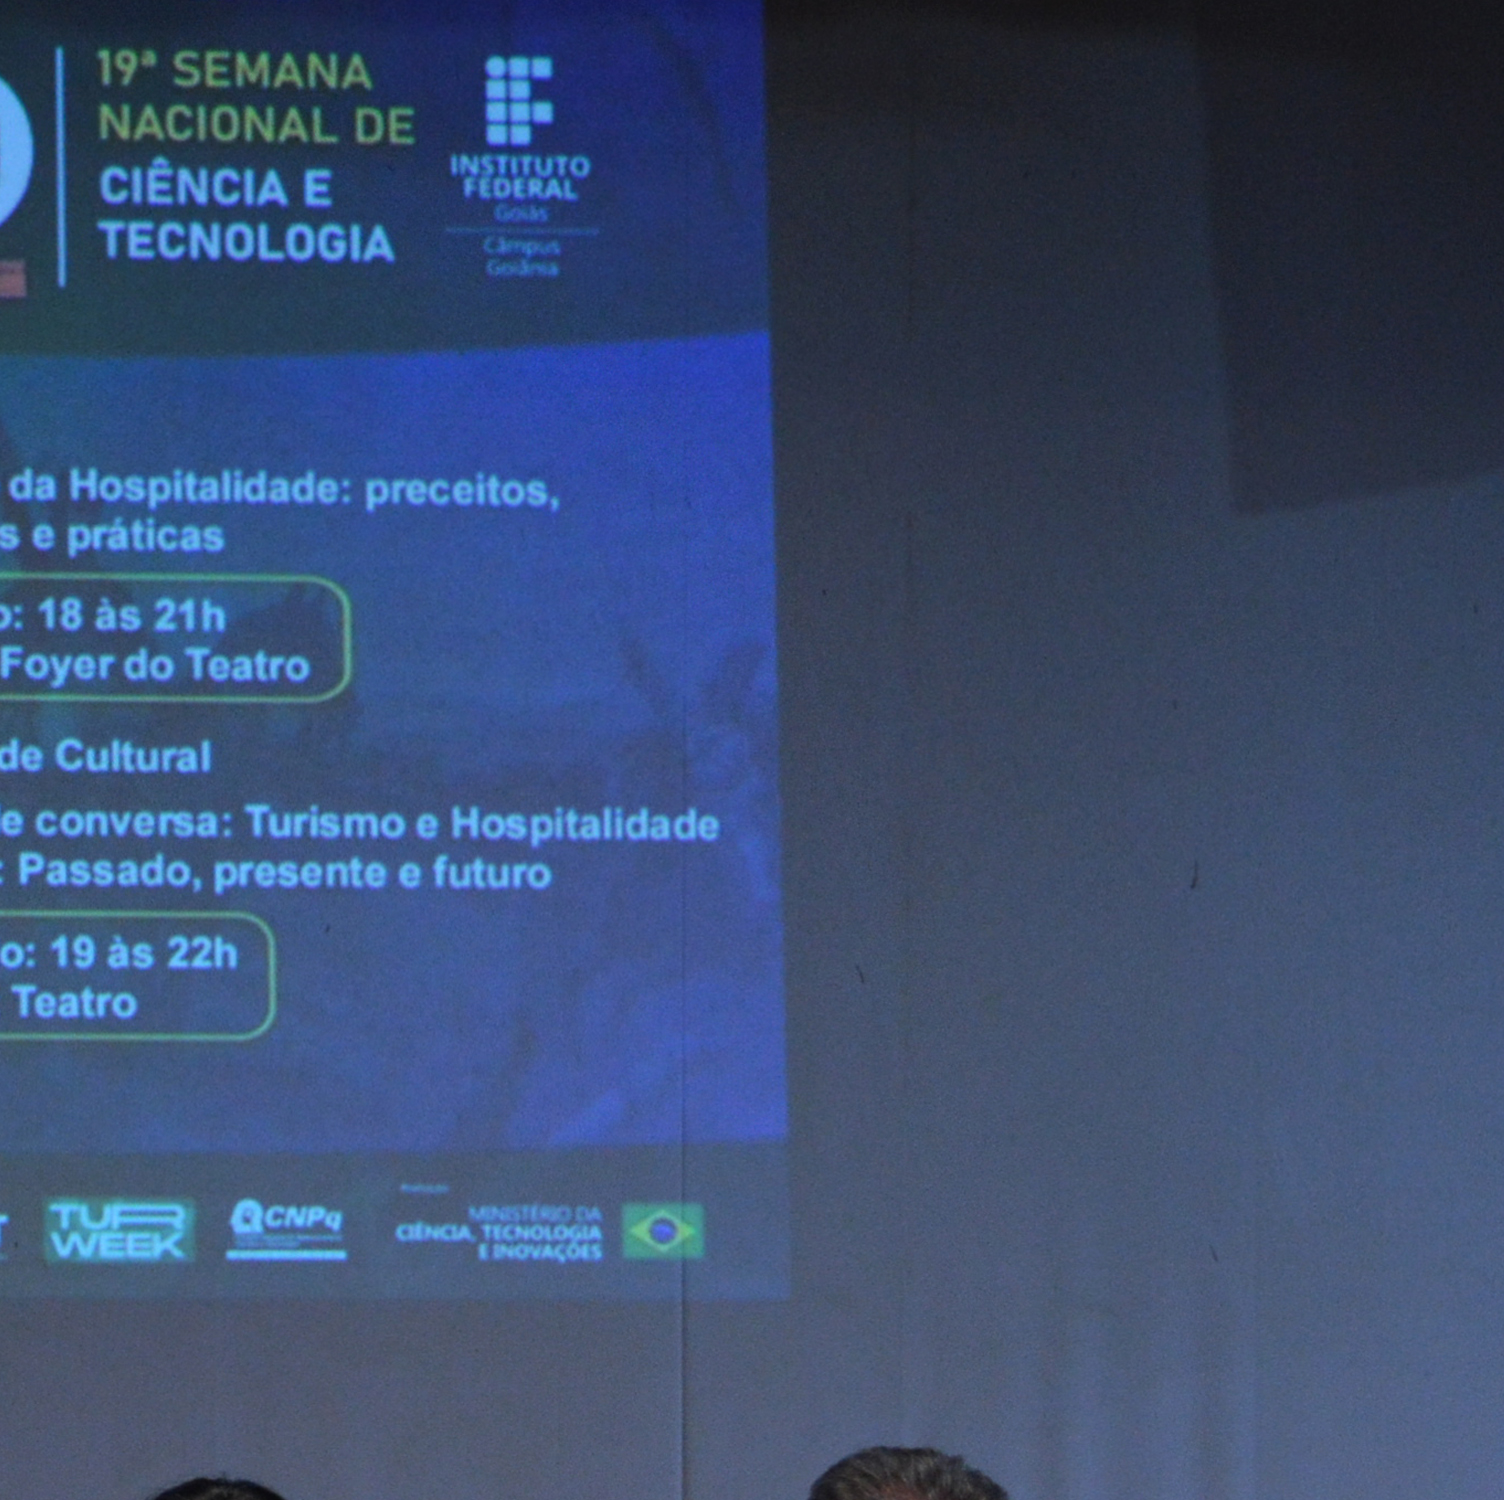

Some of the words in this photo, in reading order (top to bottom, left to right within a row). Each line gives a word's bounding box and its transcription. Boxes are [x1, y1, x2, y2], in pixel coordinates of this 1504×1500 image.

[173, 51, 373, 92] SEMANA
[97, 104, 338, 145] NACIONAL
[355, 107, 415, 145] DE
[99, 155, 289, 207] CIÊNCIA
[305, 168, 332, 207] E
[450, 154, 591, 179] INSTITUTO
[463, 177, 578, 201] FEDERAL
[98, 220, 395, 263] TECNOLOGIA
[8, 466, 56, 500] da
[69, 469, 351, 508] Hospitalidade:
[365, 473, 560, 512] preceitos,
[32, 525, 55, 550] e
[68, 518, 225, 557] práticas
[38, 599, 82, 631] 18
[95, 600, 141, 632] às
[154, 600, 225, 632] 21h
[0, 647, 114, 687] Foyer
[124, 648, 175, 681] do
[186, 648, 310, 682] Teatro
[55, 740, 211, 774] Cultural
[34, 808, 233, 838] conversa:
[244, 804, 405, 839] Turismo
[416, 815, 438, 840] e
[452, 806, 720, 846] Hospitalidade
[19, 853, 203, 893] Passado,
[214, 859, 387, 893] presente
[399, 864, 422, 889] e
[432, 856, 552, 890] futuro
[50, 935, 96, 969] 19
[107, 935, 153, 969] às
[167, 936, 238, 970] 22h
[11, 985, 138, 1018] Teatro
[265, 1204, 344, 1233] CNPq
[394, 1220, 477, 1243] CIÊNCIA,
[481, 1223, 603, 1242] TECNOLOGIA
[575, 1206, 603, 1224] DA
[49, 1231, 185, 1259] WEEK
